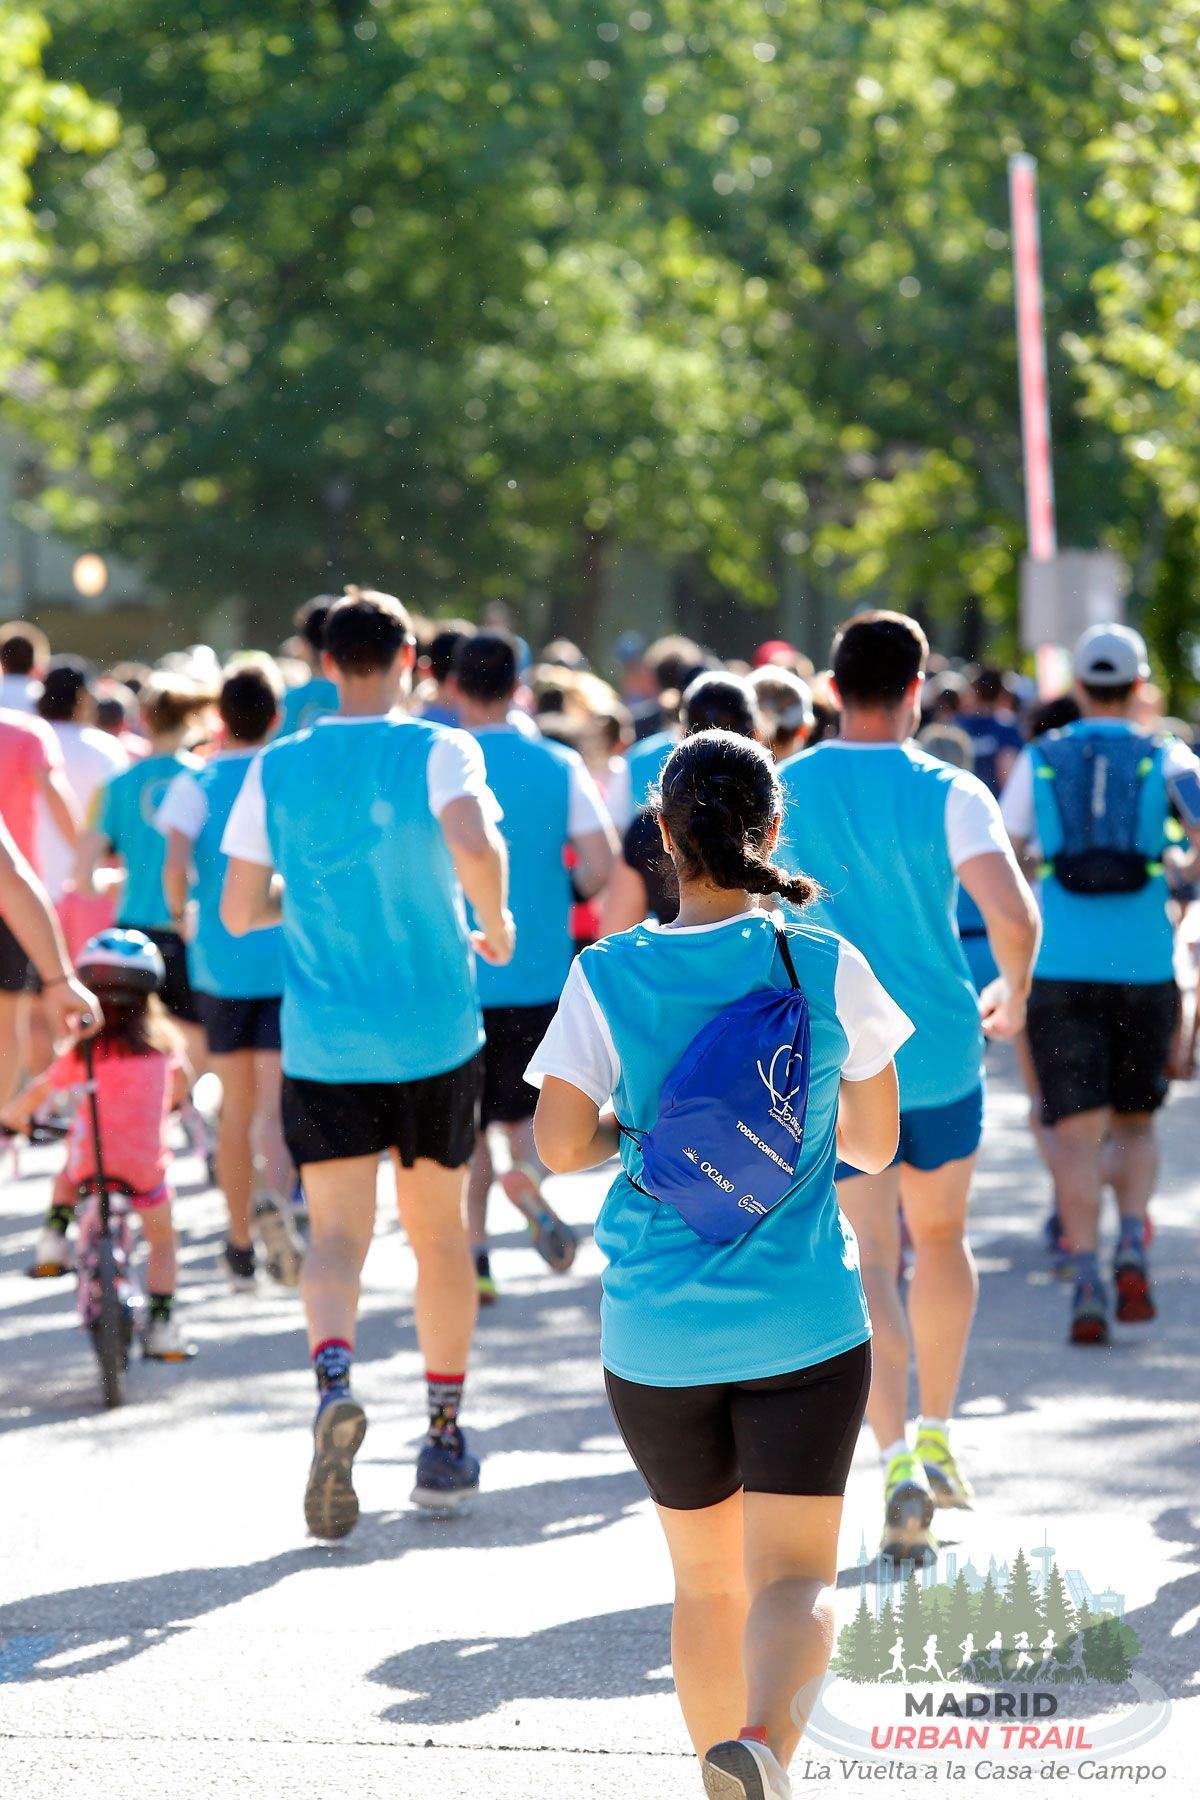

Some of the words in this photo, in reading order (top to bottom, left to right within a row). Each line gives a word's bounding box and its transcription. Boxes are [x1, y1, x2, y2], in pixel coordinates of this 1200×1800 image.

[735, 1120, 760, 1145] TODOS
[757, 1141, 780, 1163] CONTRA
[700, 1161, 736, 1194] OCASO
